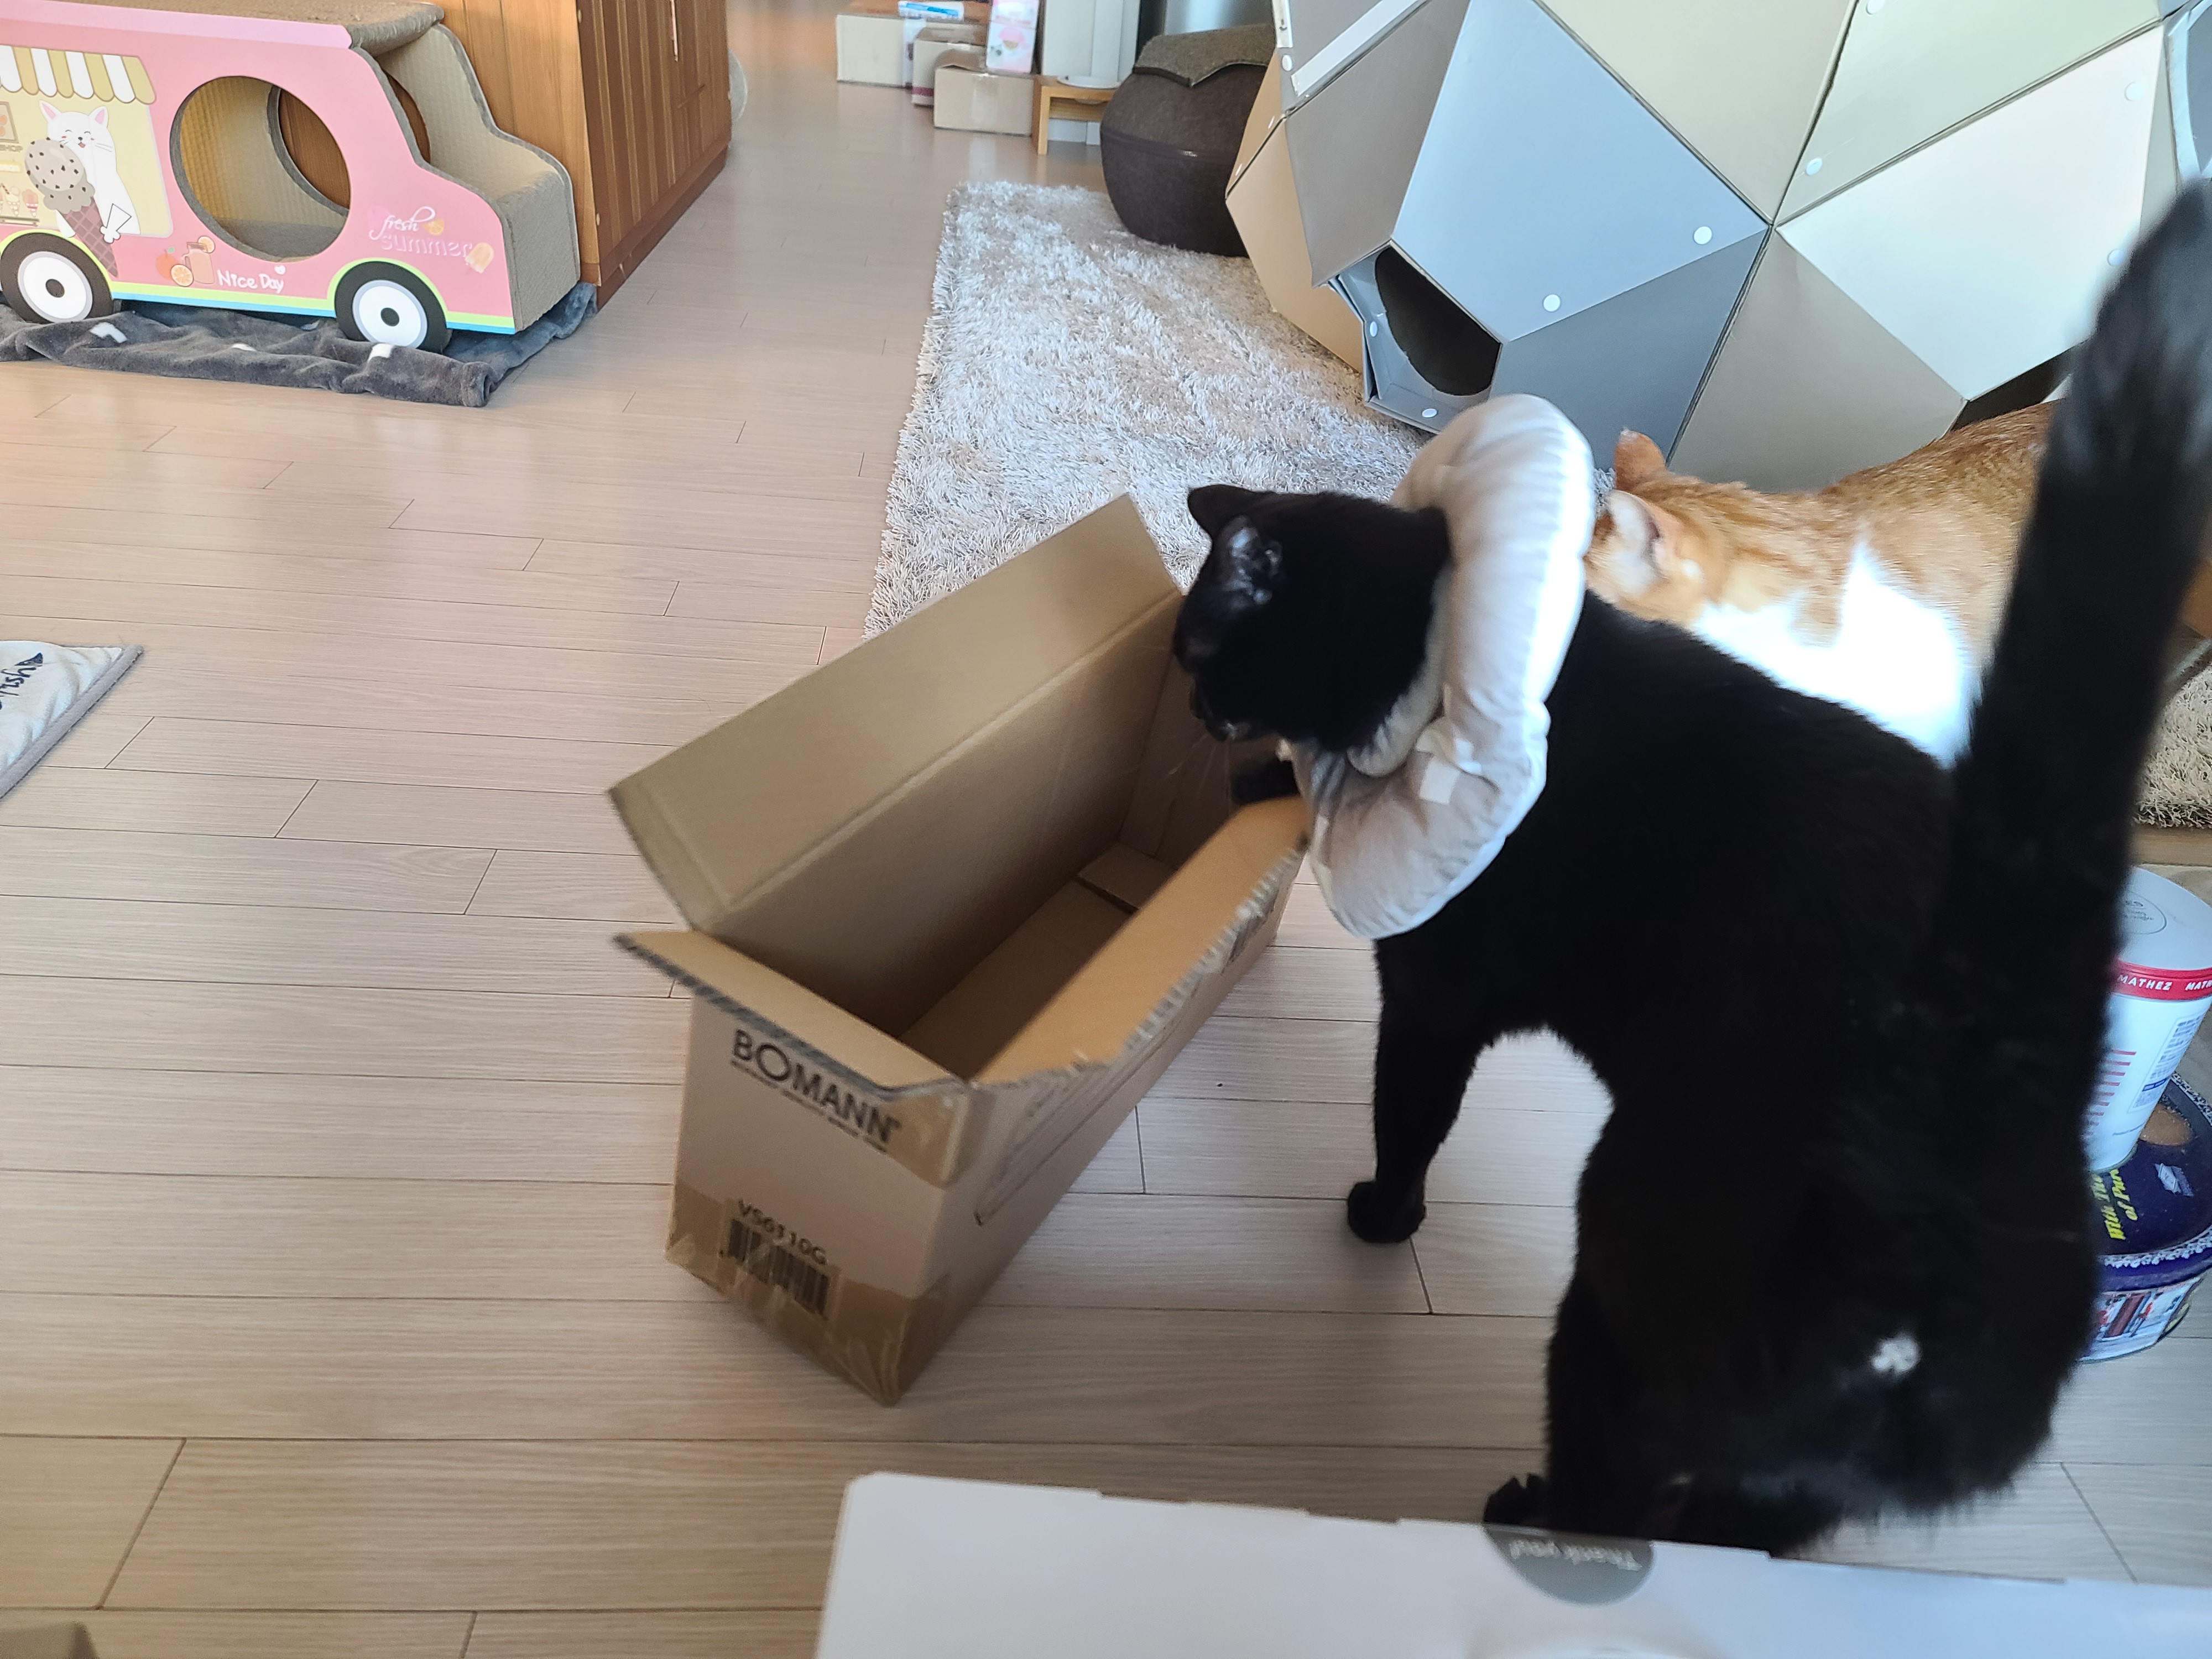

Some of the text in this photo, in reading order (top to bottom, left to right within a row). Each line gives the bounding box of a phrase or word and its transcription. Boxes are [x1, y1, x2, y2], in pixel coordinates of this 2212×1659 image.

[368, 206, 436, 240] fresh
[381, 233, 473, 258] summer
[217, 269, 284, 294] Nice Day
[2117, 974, 2173, 991] MATHEZ
[733, 1029, 893, 1144] BOMANN
